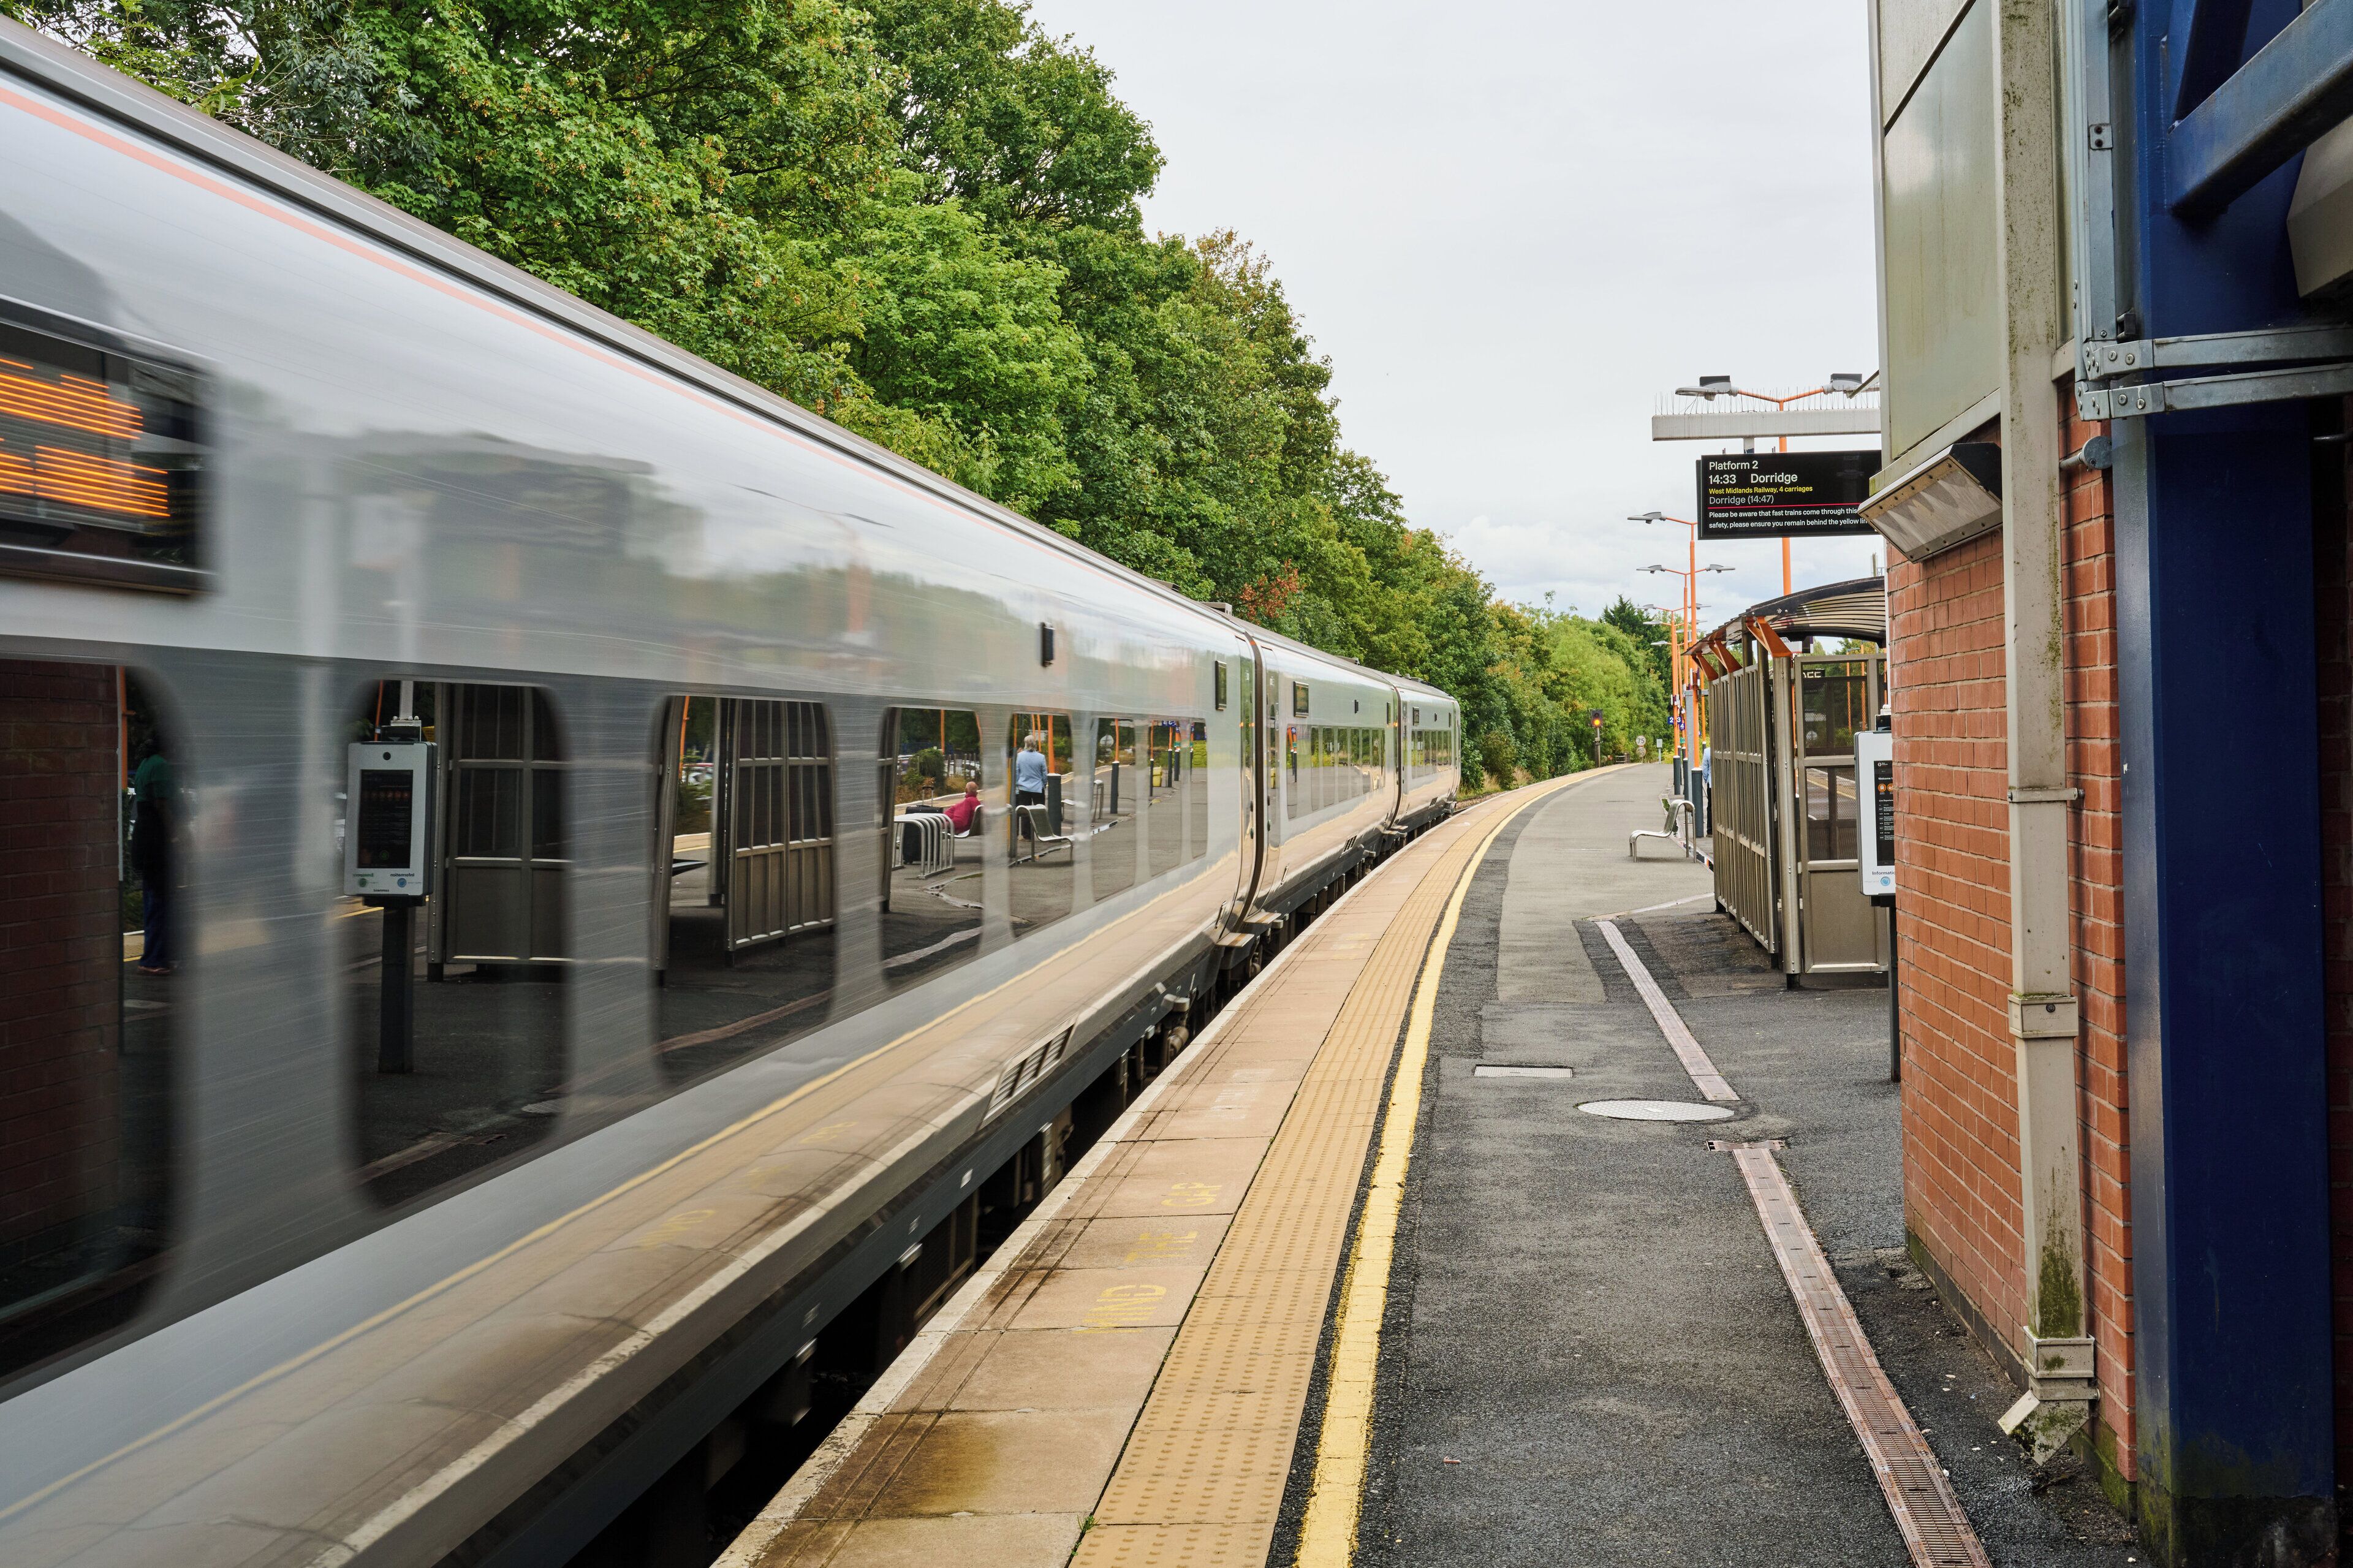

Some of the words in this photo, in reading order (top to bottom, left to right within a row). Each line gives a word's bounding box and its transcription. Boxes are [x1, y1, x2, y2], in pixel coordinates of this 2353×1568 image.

[1710, 461, 1749, 470] Platform
[1752, 460, 1758, 469] 2
[1709, 474, 1736, 484] 14:33
[1751, 472, 1797, 484] Dorridge
[1710, 496, 1746, 505] Dorridge
[1748, 495, 1773, 504] (14:47)
[1072, 1284, 1167, 1334] MIND
[1124, 1230, 1198, 1262] THE
[1161, 1181, 1222, 1207] GAP
